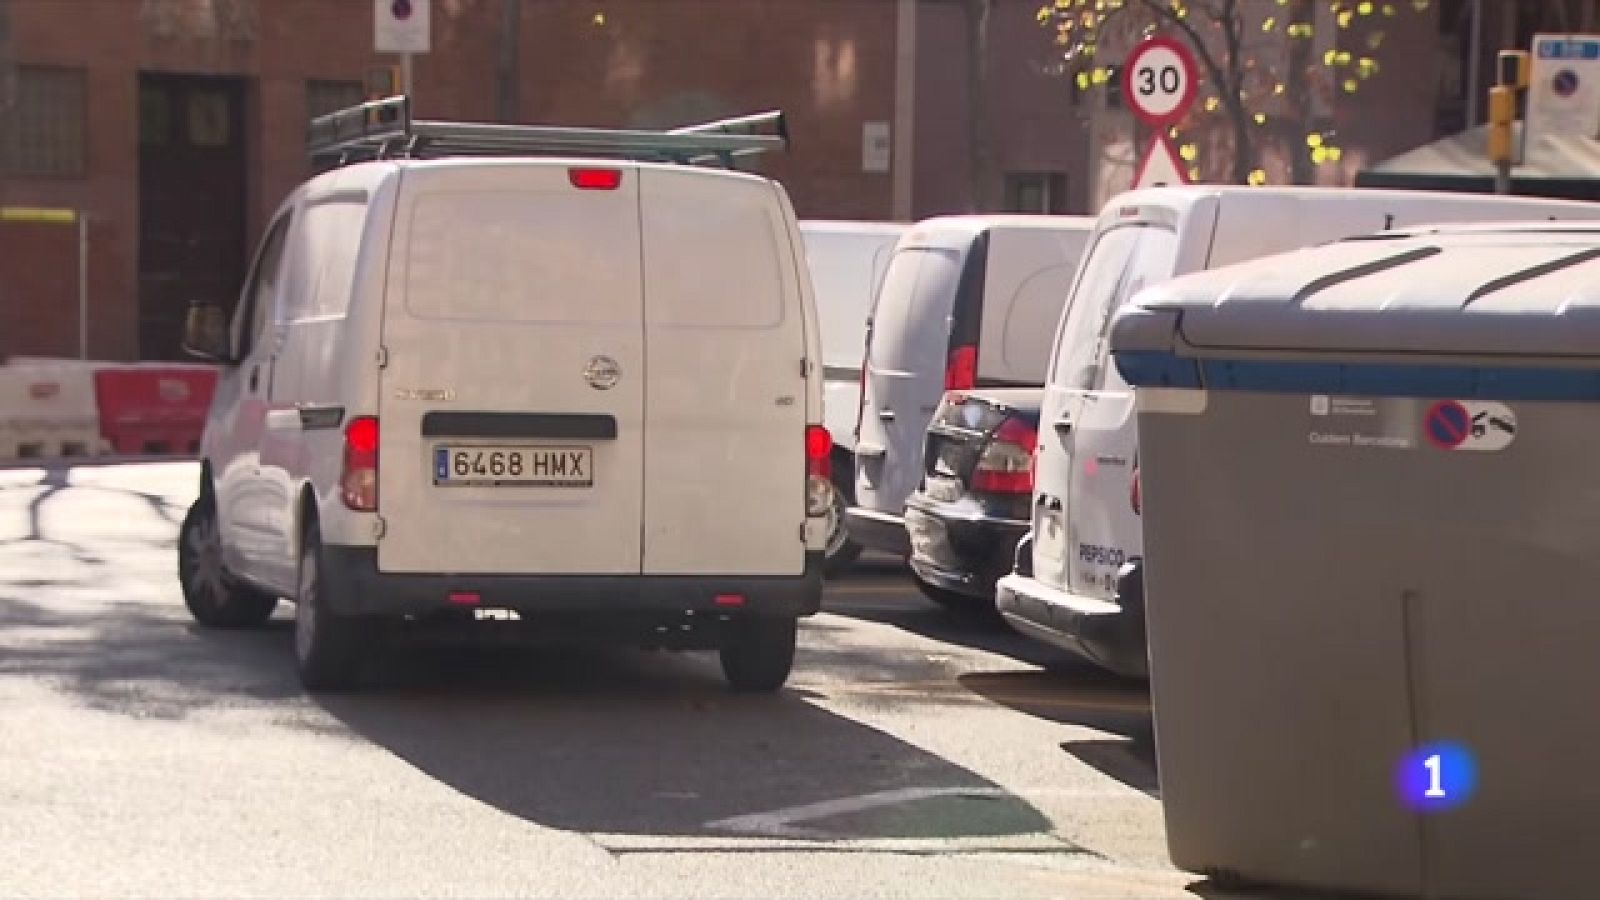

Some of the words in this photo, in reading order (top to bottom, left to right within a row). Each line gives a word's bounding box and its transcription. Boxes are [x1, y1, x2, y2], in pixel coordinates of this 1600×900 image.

[1138, 65, 1180, 95] 30
[454, 452, 523, 475] 6468
[534, 452, 583, 476] HMX
